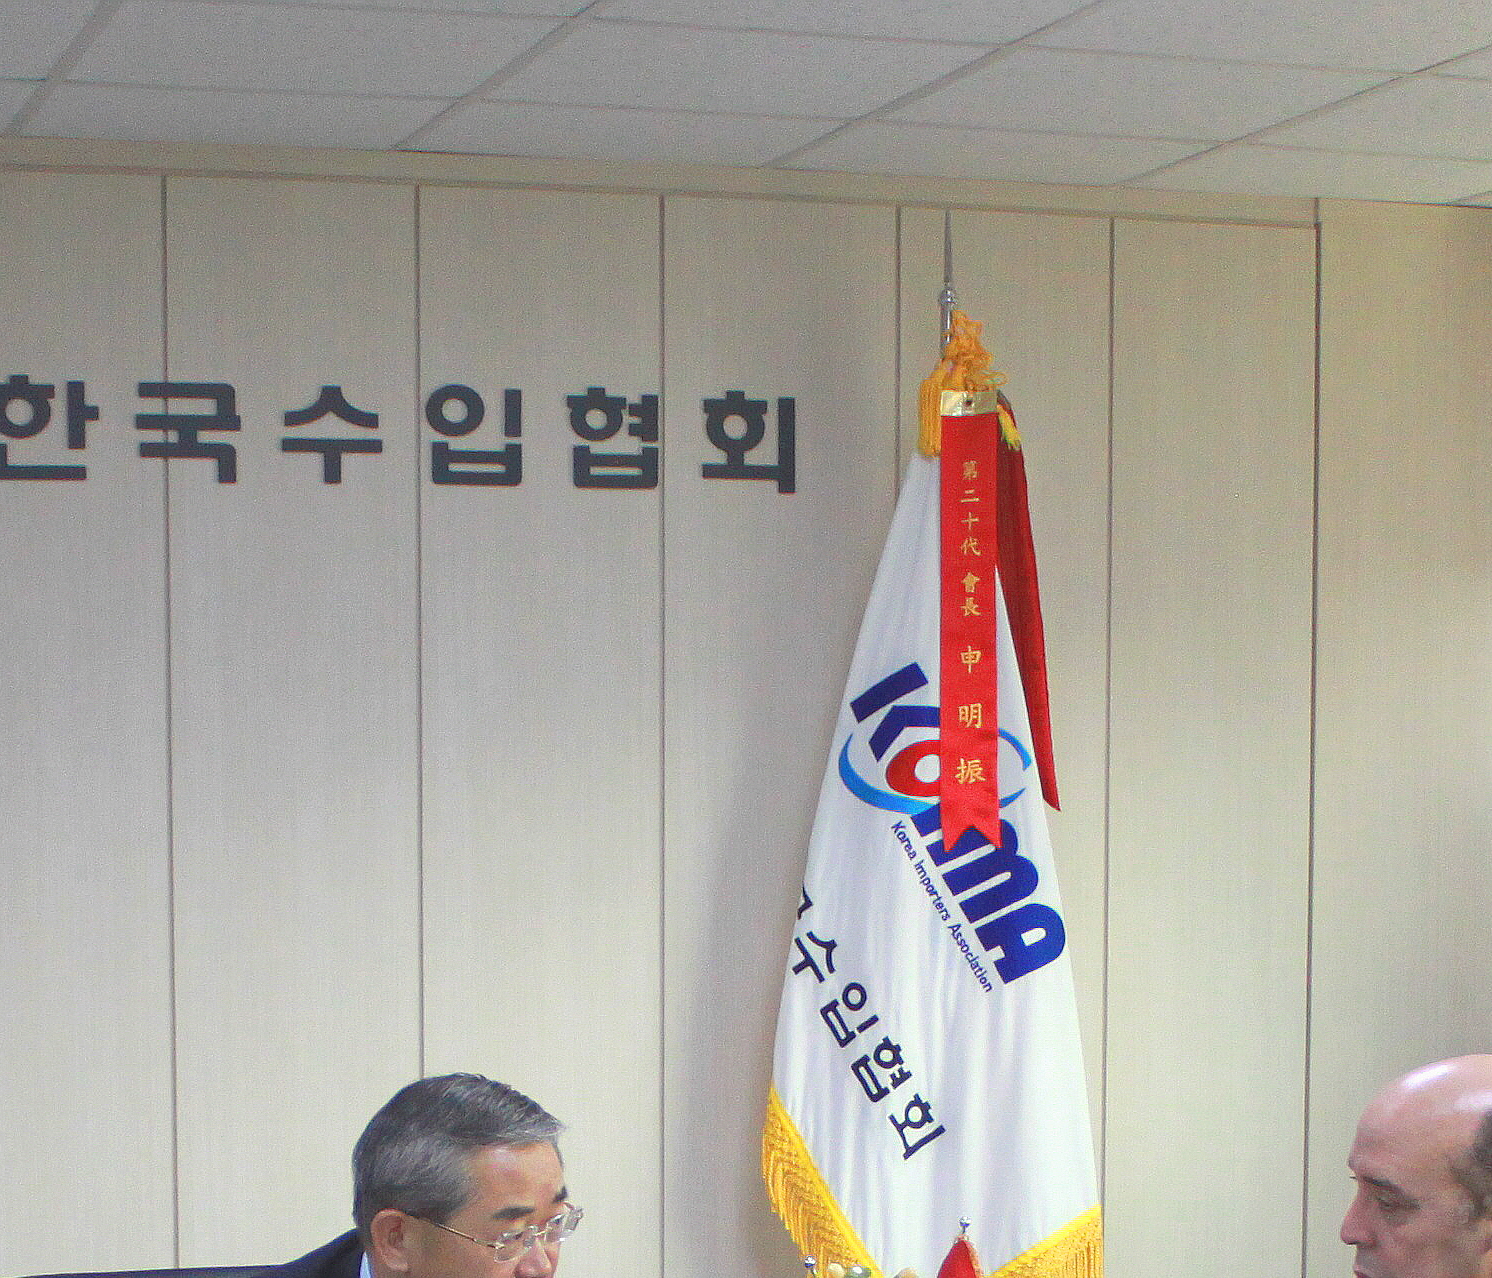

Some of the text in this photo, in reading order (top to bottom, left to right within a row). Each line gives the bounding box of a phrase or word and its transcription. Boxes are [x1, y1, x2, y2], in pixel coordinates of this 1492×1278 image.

[891, 820, 993, 993] Korea Importers Association
[791, 886, 947, 1160] 수입협회
